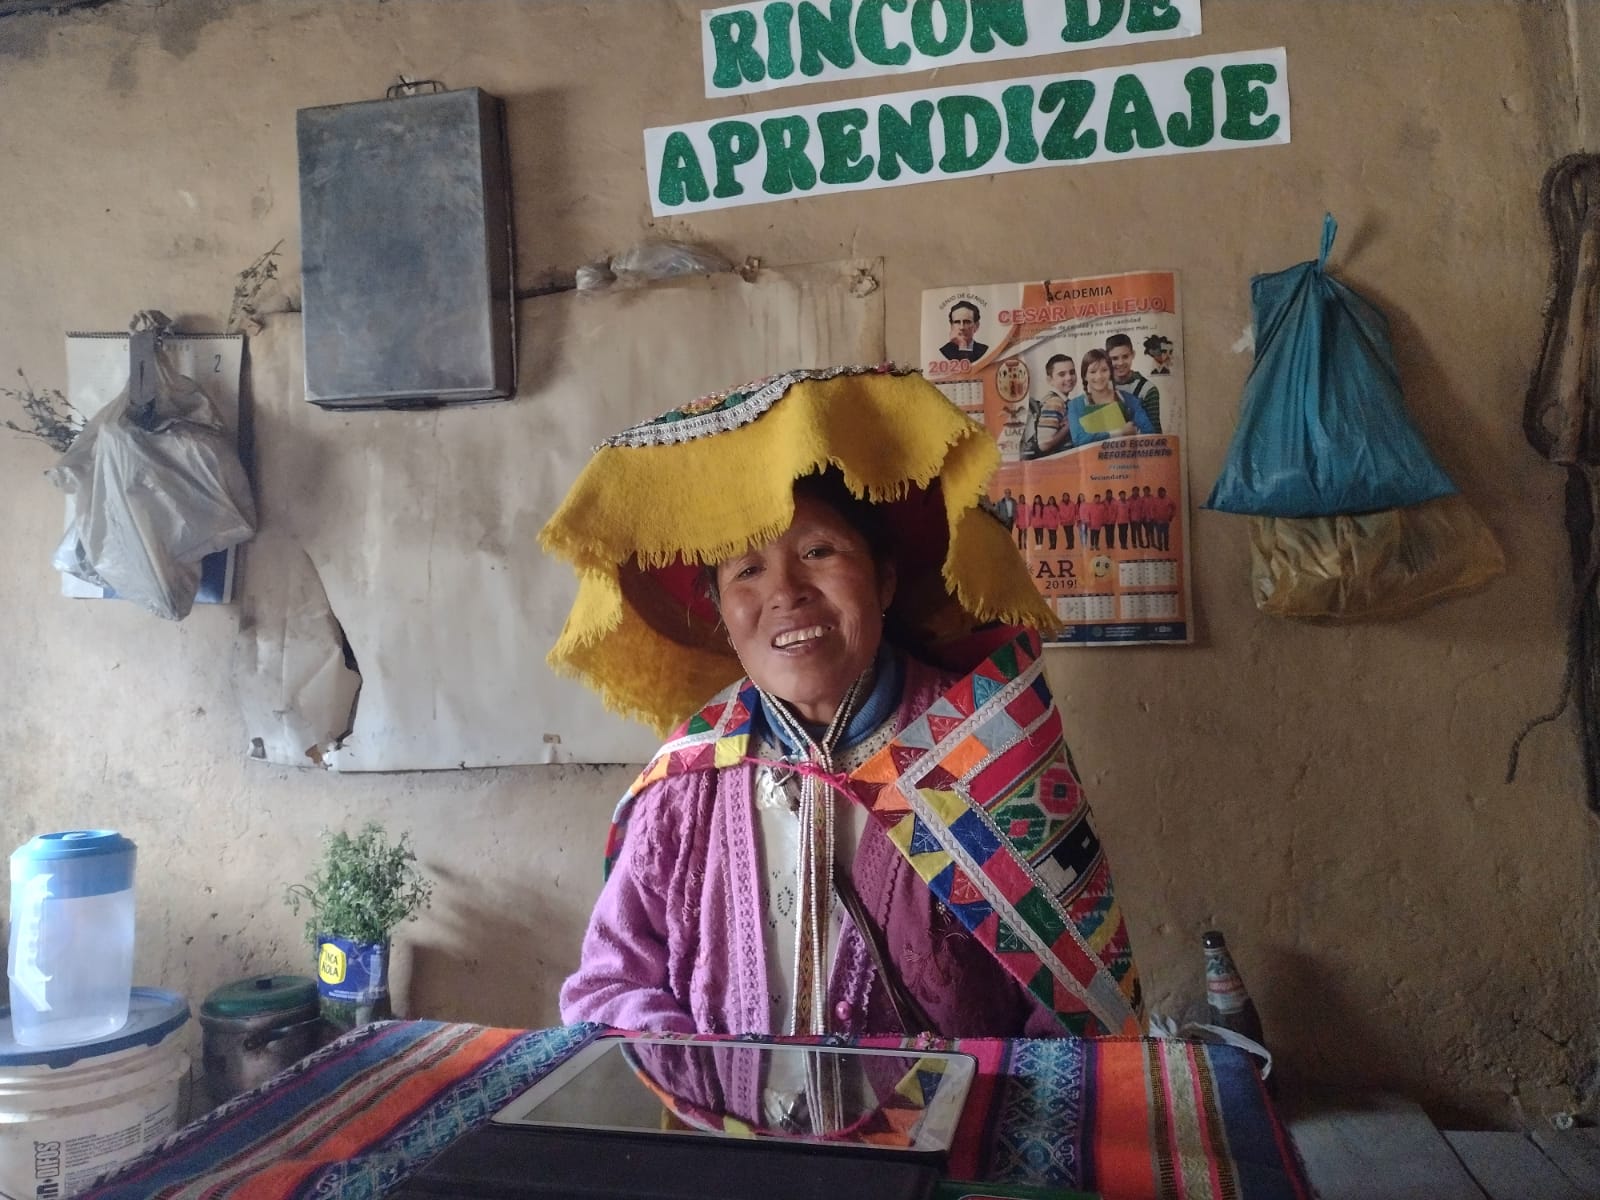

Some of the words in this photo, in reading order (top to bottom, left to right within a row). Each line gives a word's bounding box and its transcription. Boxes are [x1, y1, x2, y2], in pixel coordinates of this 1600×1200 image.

[709, 0, 1028, 88] RINCON
[658, 63, 1280, 206] APRENDIZAJE
[998, 306, 1065, 326] CESAR
[1072, 297, 1167, 317] VALLEJO
[214, 354, 221, 373] 2
[928, 359, 970, 374] 2020
[1101, 440, 1126, 449] CICLO
[1129, 438, 1167, 448] ESCOLAR
